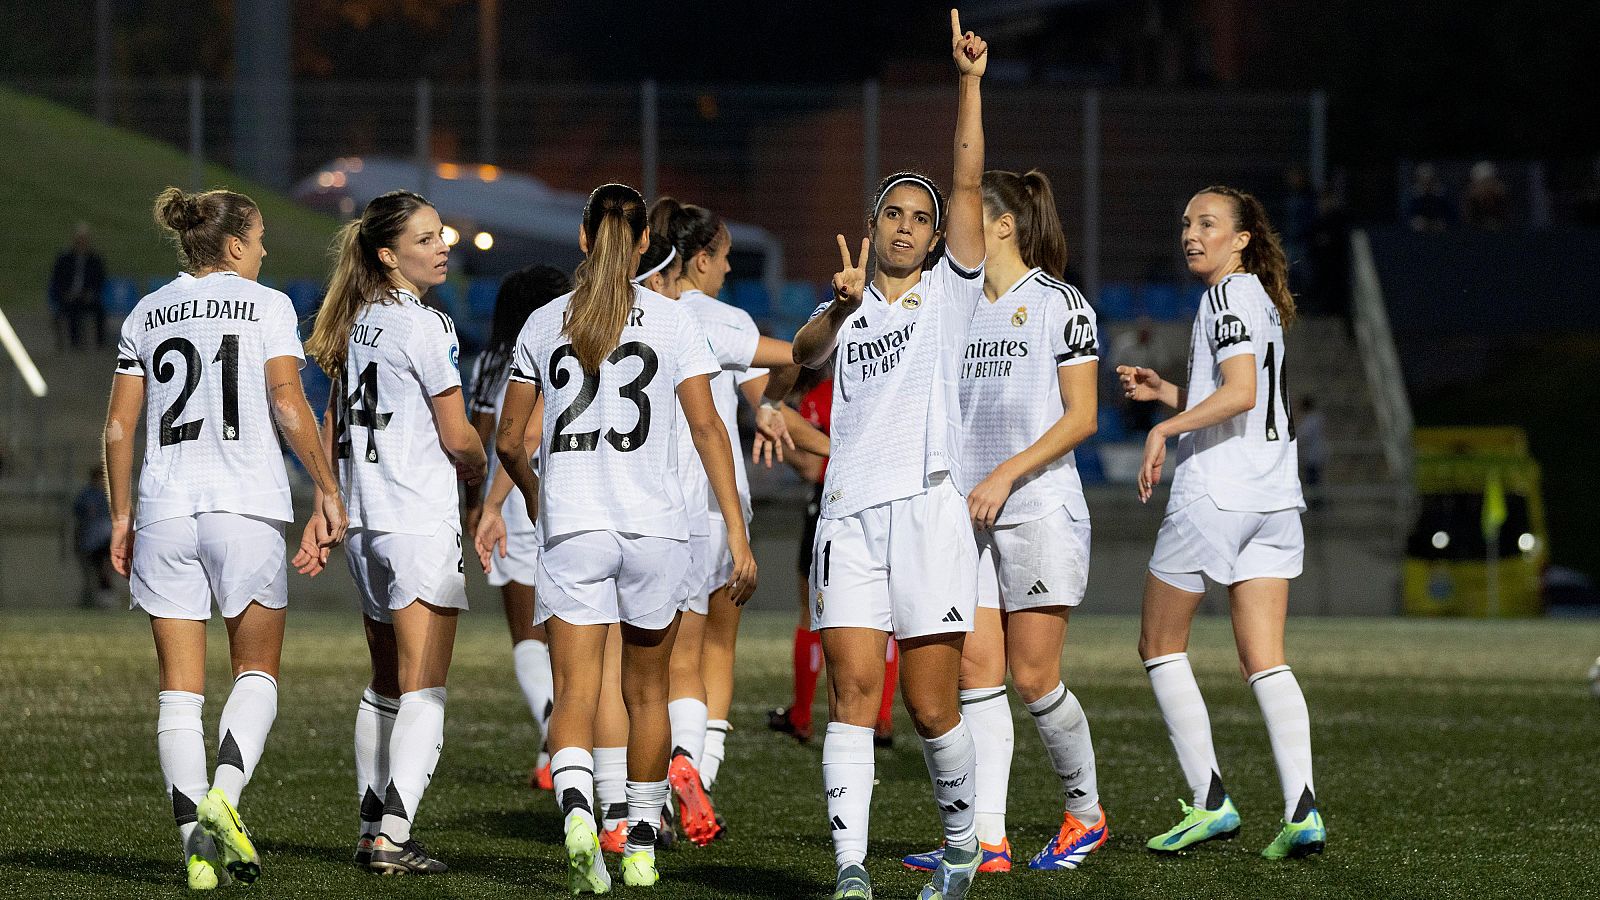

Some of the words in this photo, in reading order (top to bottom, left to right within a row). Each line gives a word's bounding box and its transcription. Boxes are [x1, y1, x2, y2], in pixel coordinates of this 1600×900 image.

[144, 299, 260, 331] ANGELDAHL
[349, 323, 383, 348] POLZ
[847, 321, 916, 364] Emirat
[1067, 314, 1093, 349] hp
[960, 362, 973, 379] LY
[975, 360, 1012, 378] BETTER
[152, 333, 240, 448] 21
[549, 341, 658, 454] 23
[826, 786, 847, 800] MCF
[936, 772, 968, 788] RMCF
